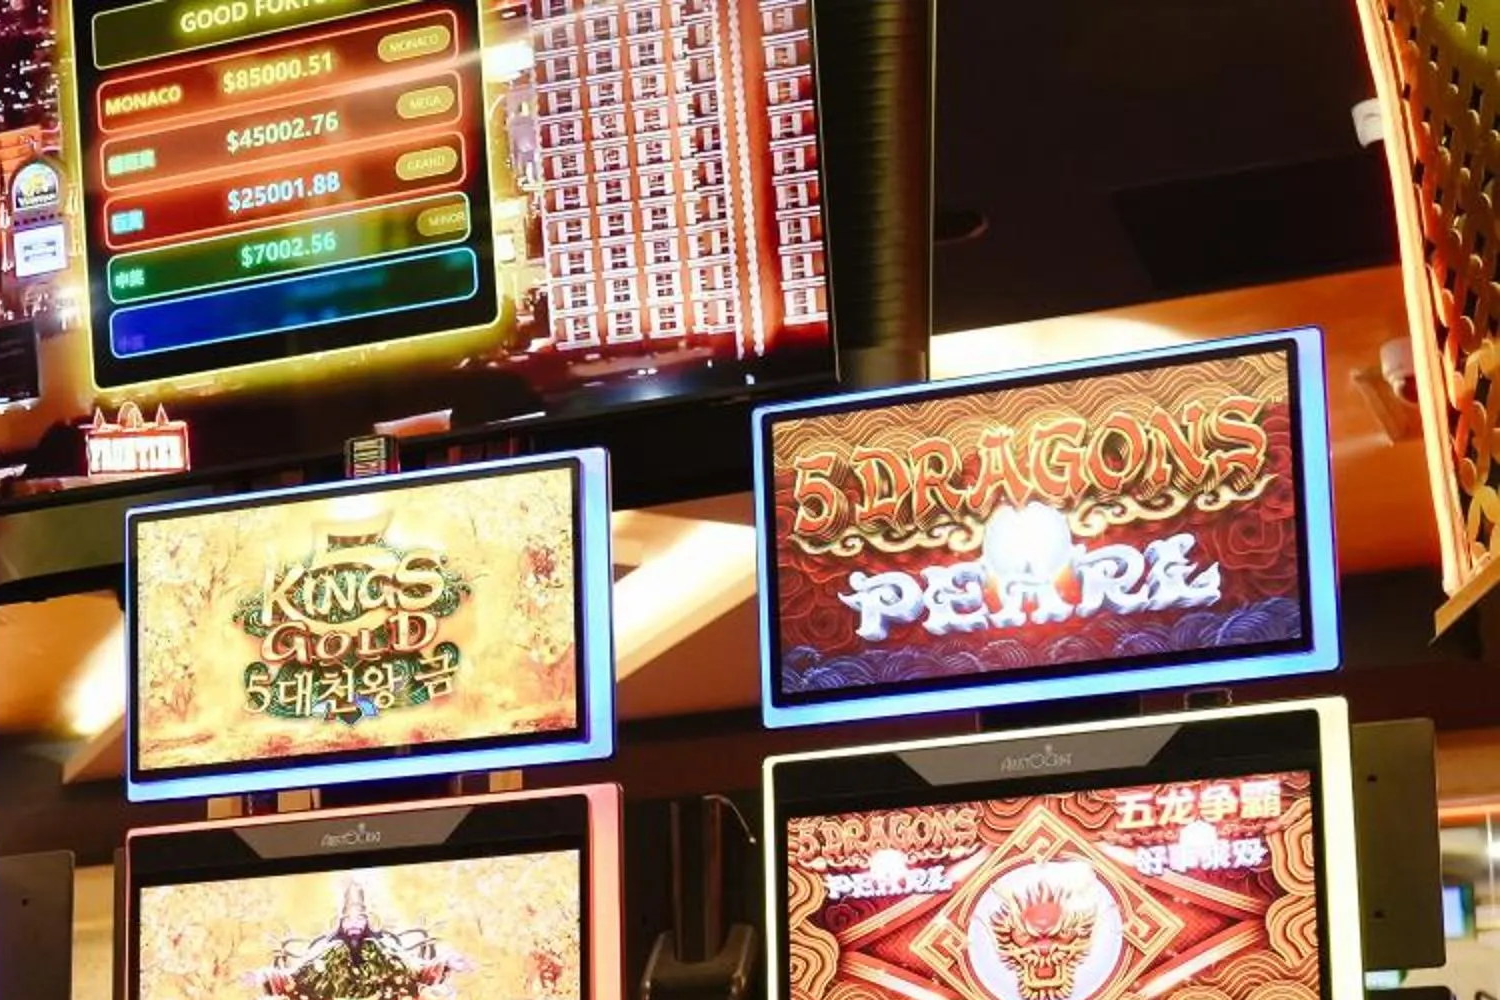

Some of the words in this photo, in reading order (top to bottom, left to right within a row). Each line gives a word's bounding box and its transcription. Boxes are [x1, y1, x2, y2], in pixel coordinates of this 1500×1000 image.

[180, 1, 248, 33] GOOD
[104, 85, 183, 117] MONACO
[222, 52, 334, 94] $85000.51
[226, 111, 339, 153] $45002.76
[227, 172, 340, 213] $25001.88
[240, 231, 337, 268] $7002.56
[794, 452, 836, 534] 5
[851, 396, 1270, 524] DRAGONS
[261, 545, 446, 626] KINGS
[838, 534, 1221, 641] PEARL
[261, 611, 439, 665] GOLD
[1115, 780, 1282, 829] 五龙争霸
[821, 810, 978, 858] DRAGONS
